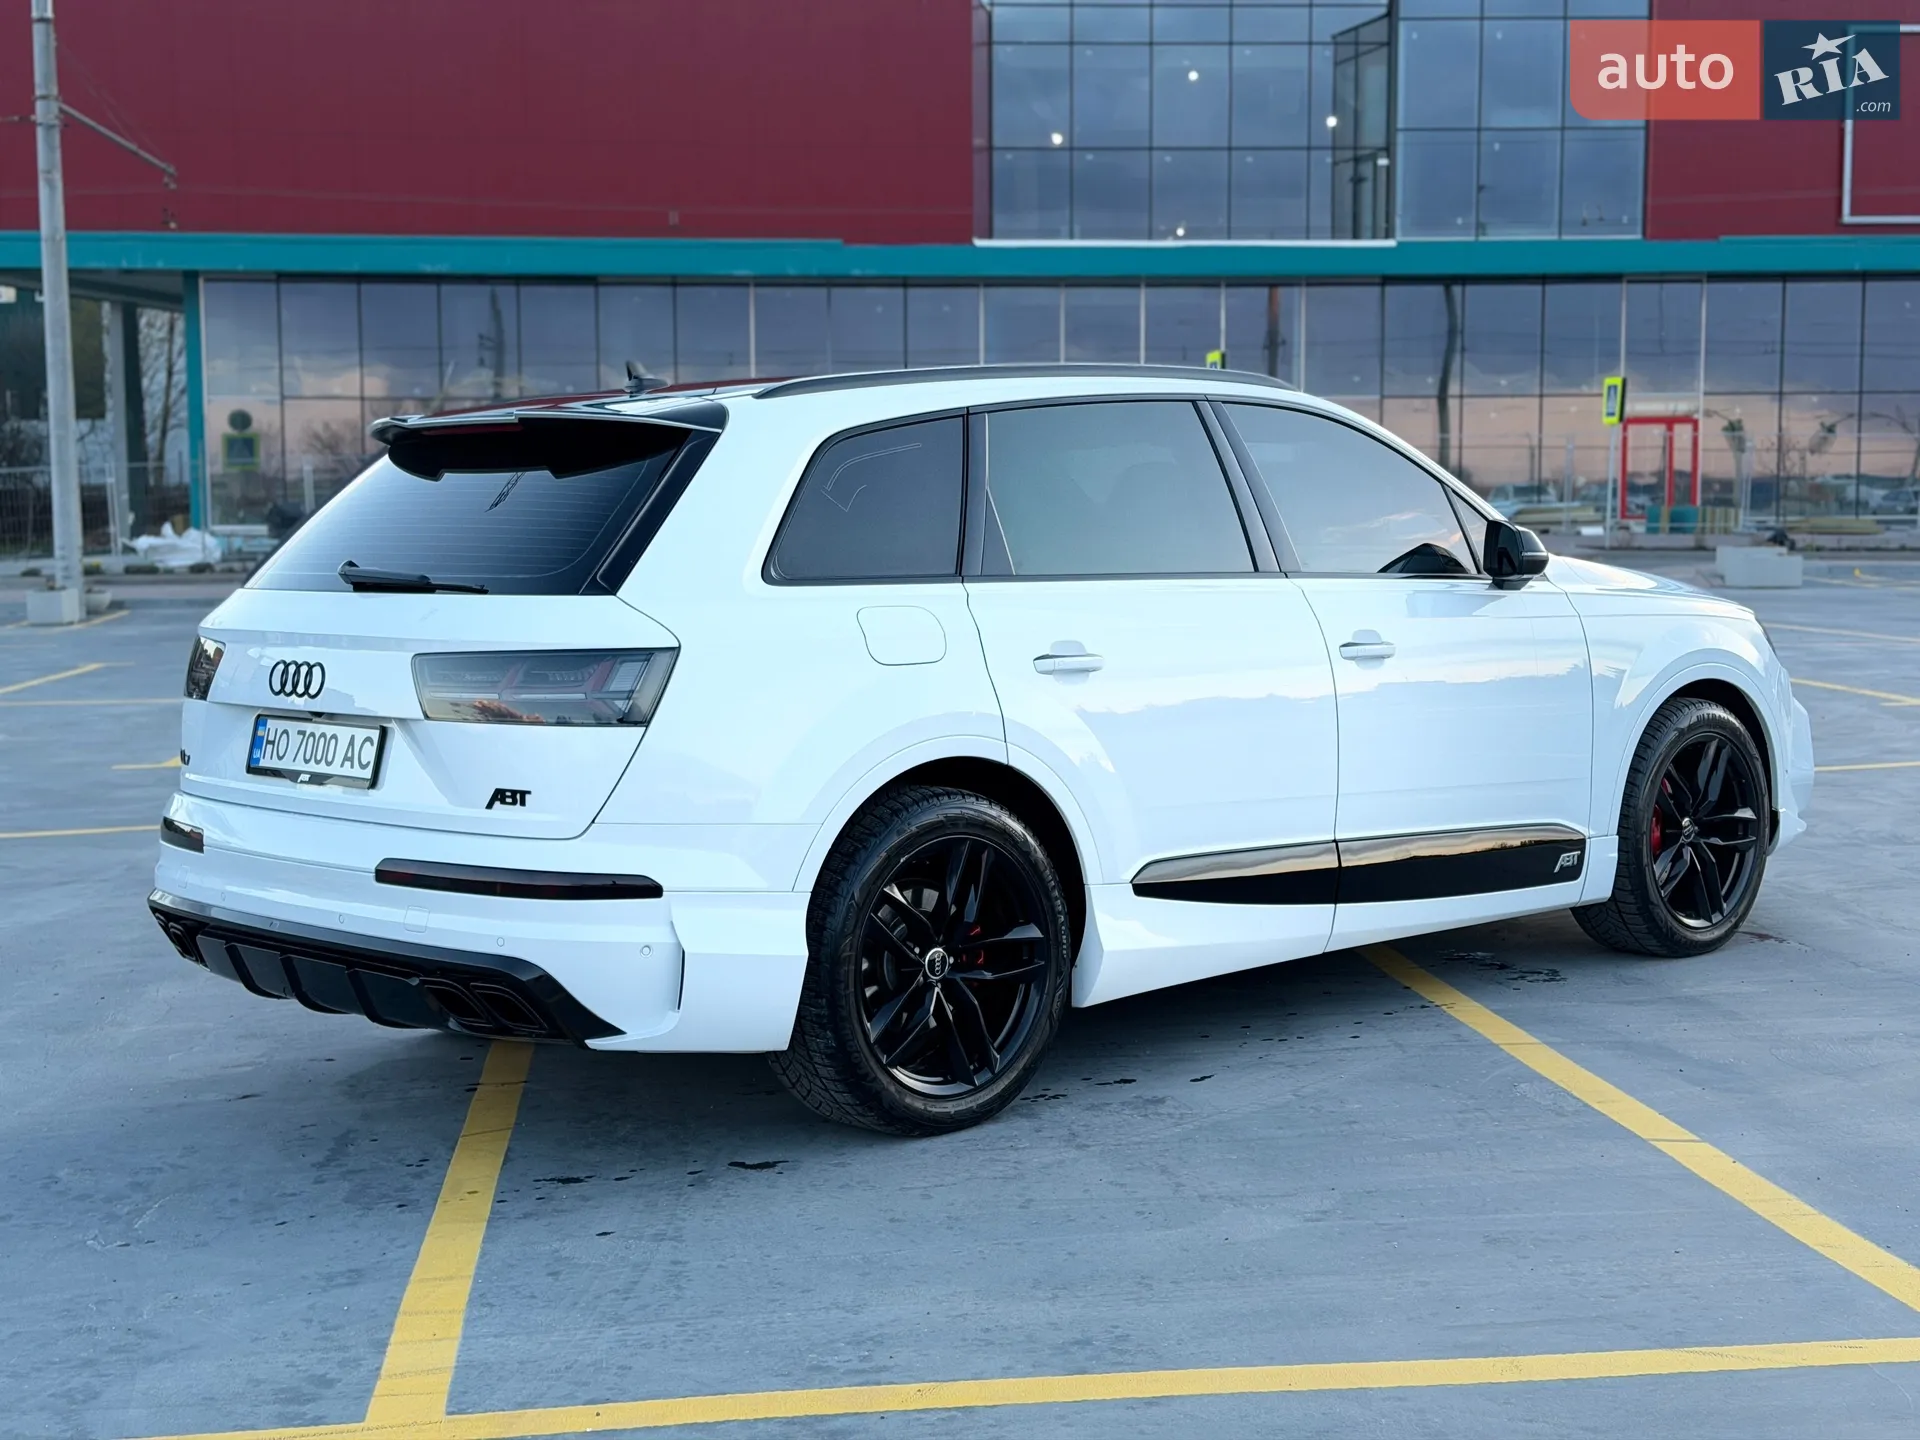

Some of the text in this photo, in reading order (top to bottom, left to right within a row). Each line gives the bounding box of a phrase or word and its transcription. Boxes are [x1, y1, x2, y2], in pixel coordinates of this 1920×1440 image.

[262, 727, 375, 770] HO 7000 AC
[485, 787, 532, 810] ABT
[1553, 850, 1581, 873] ABT
